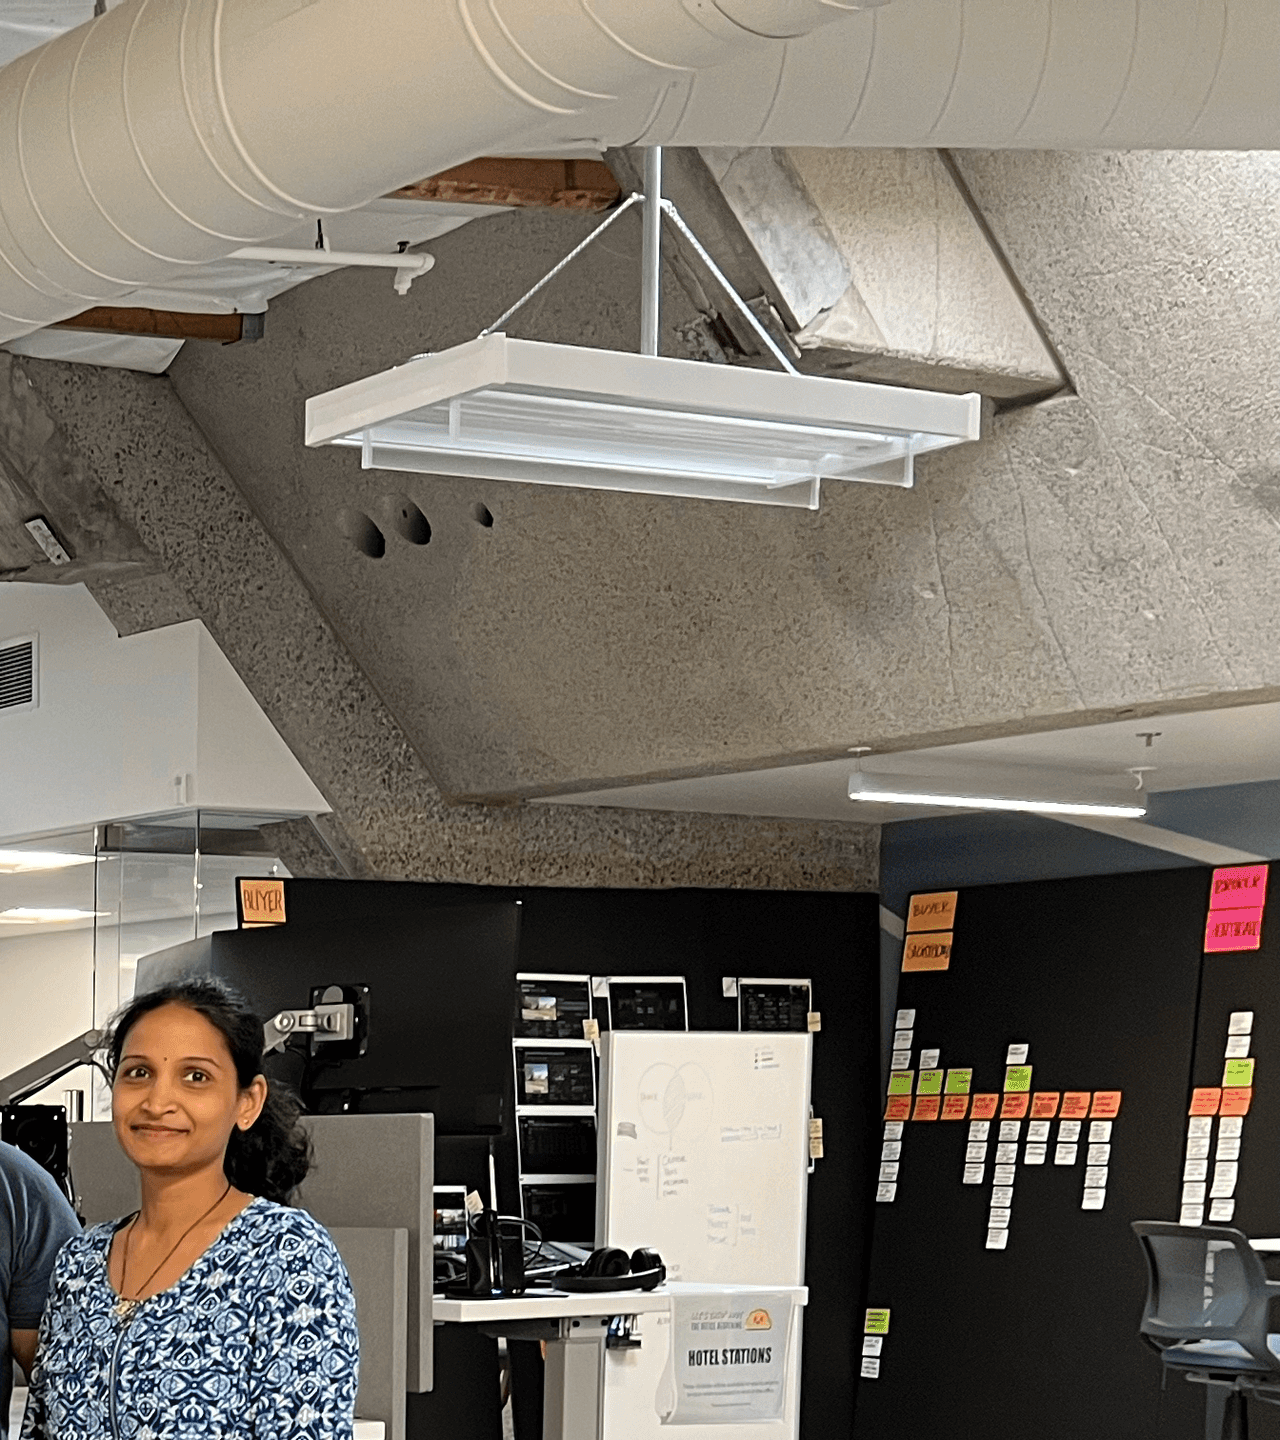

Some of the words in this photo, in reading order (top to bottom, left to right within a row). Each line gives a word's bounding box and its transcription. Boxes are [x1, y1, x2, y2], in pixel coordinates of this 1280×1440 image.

[244, 889, 283, 912] BUYER
[913, 901, 950, 917] BUYER
[688, 1349, 720, 1367] HOTEL
[721, 1346, 772, 1365] STATIONS
